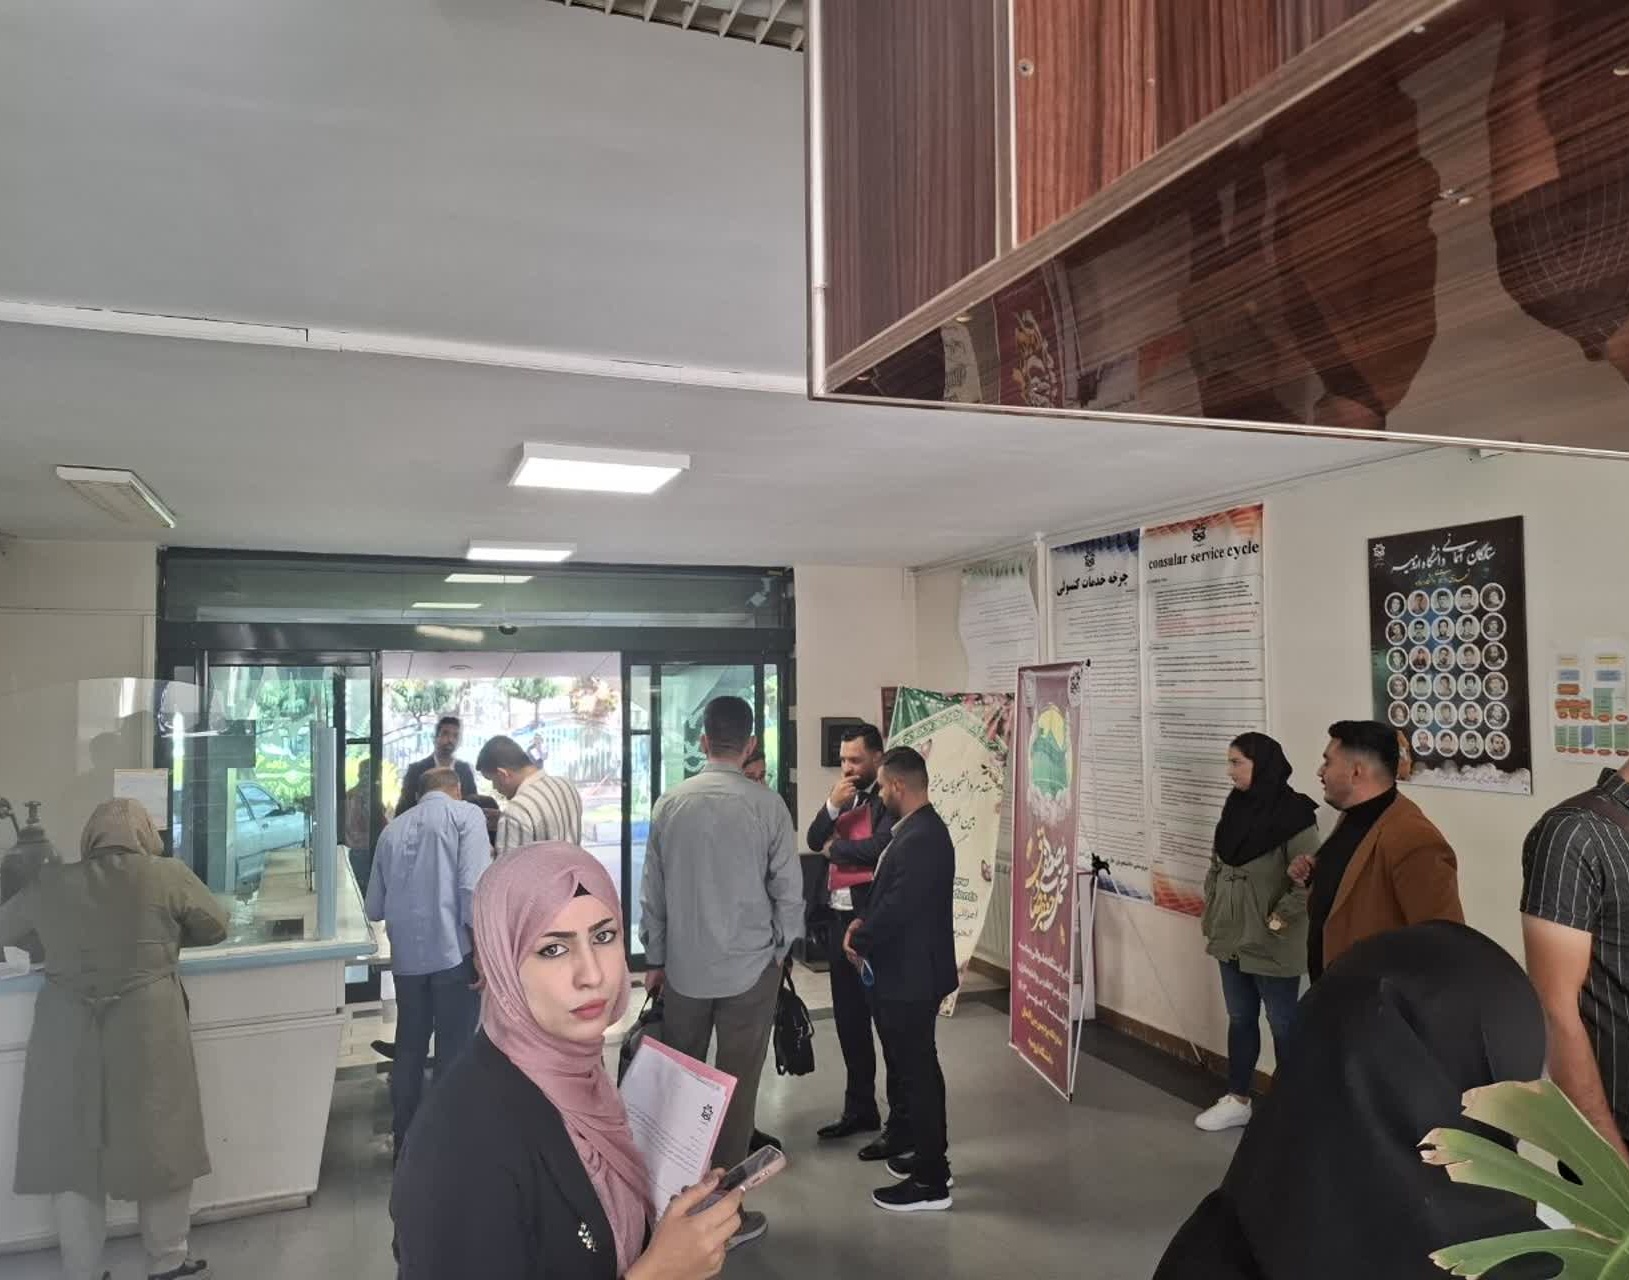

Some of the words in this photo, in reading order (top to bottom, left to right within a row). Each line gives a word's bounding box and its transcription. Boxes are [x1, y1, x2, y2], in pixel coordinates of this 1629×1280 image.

[1149, 552, 1188, 569] consular
[1190, 546, 1225, 563] service
[1227, 540, 1260, 560] cycle
[1082, 574, 1106, 589] خدمات
[1108, 570, 1129, 588] چرخه
